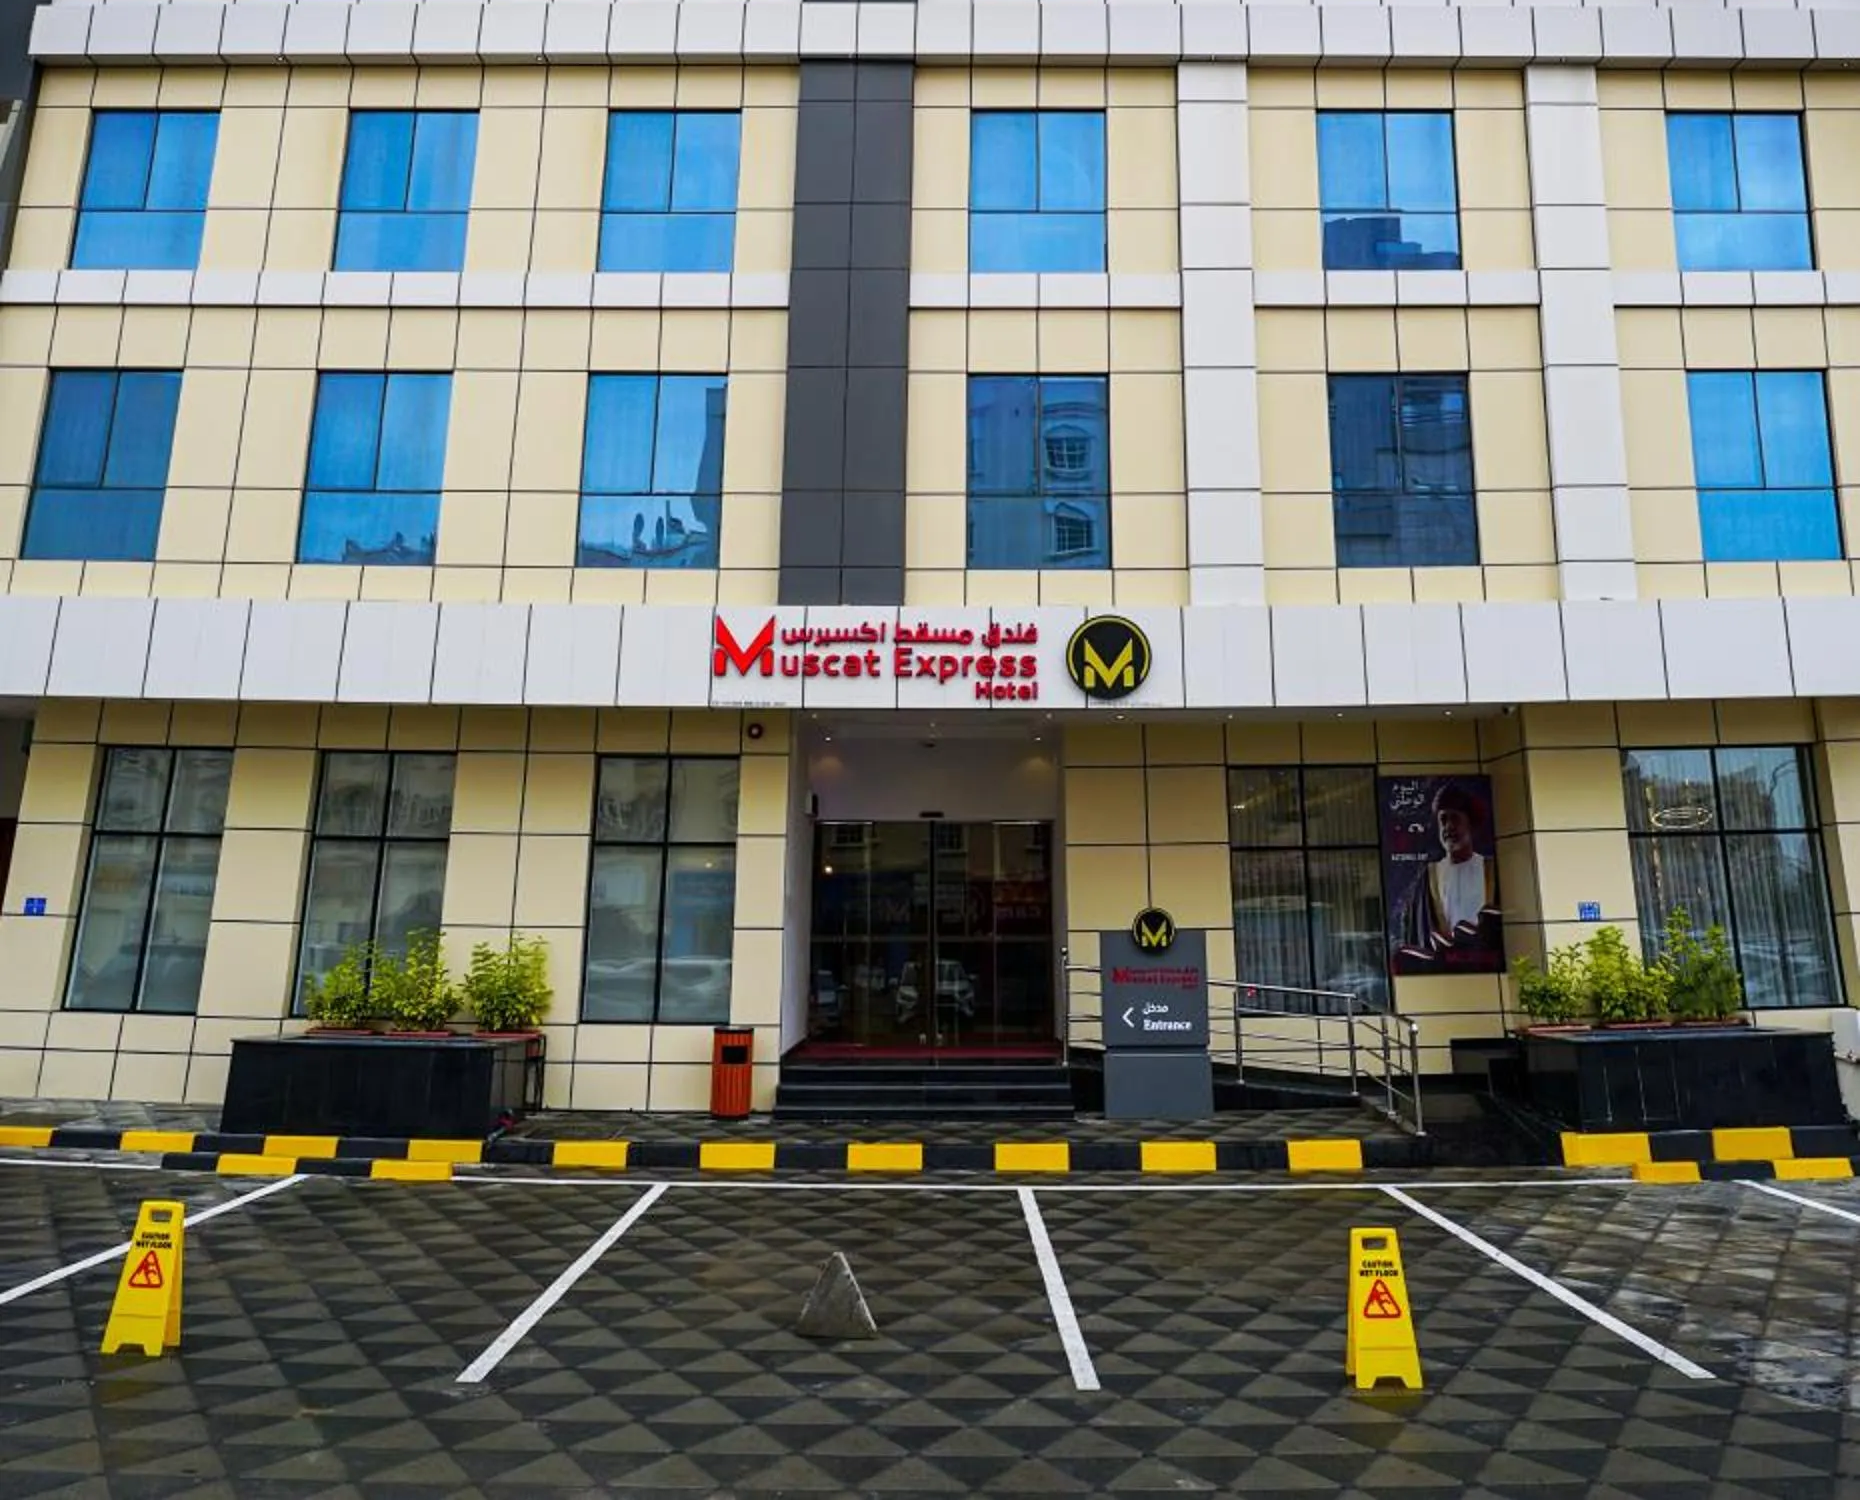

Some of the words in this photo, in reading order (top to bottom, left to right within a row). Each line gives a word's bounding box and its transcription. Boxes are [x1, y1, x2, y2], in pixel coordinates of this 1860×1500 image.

[893, 621, 974, 645] مسقط
[981, 622, 1037, 649] فندق
[713, 614, 881, 678] Muscat
[894, 647, 1037, 685] Express
[975, 681, 1038, 700] Hotel
[1143, 1019, 1192, 1031] Entrance
